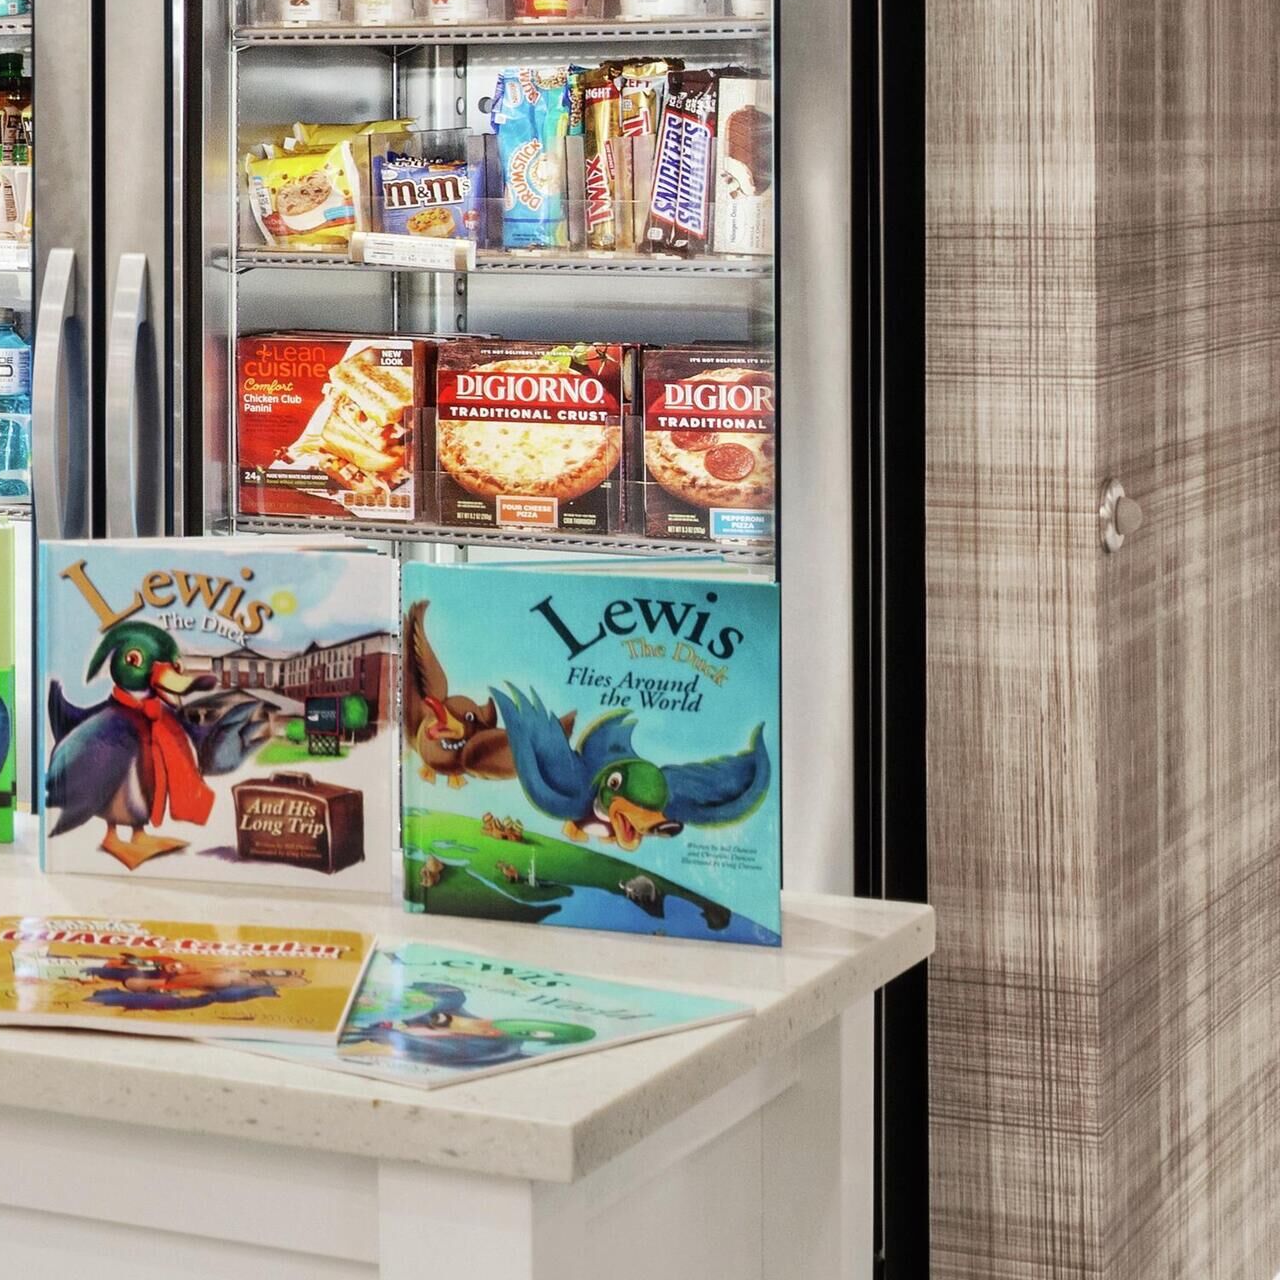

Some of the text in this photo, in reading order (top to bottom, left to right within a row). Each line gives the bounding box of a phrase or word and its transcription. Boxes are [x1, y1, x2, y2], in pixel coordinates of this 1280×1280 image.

[511, 138, 541, 210] DRUMSTICK
[654, 116, 683, 219] SNICKERS
[586, 155, 614, 232] TWIX
[381, 350, 401, 358] NEW
[381, 358, 403, 366] LOOK
[244, 378, 294, 392] Comfort
[244, 393, 302, 405] Chicken Club
[244, 404, 272, 413] Panini
[450, 406, 609, 422] TRADITIONAL CRUST
[658, 416, 766, 429] TRADITIONAL
[502, 503, 552, 513] FOUR CHEESE
[516, 510, 538, 519] PIZZA
[731, 521, 755, 529] PIZZA
[59, 559, 274, 635] Lewis
[159, 612, 250, 647] The Duck
[530, 591, 745, 661] Lewis
[620, 639, 729, 688] The Duck
[566, 666, 699, 694] Flies Around
[599, 688, 703, 714] the World
[246, 797, 317, 818] And His
[239, 814, 324, 839] Long Trip
